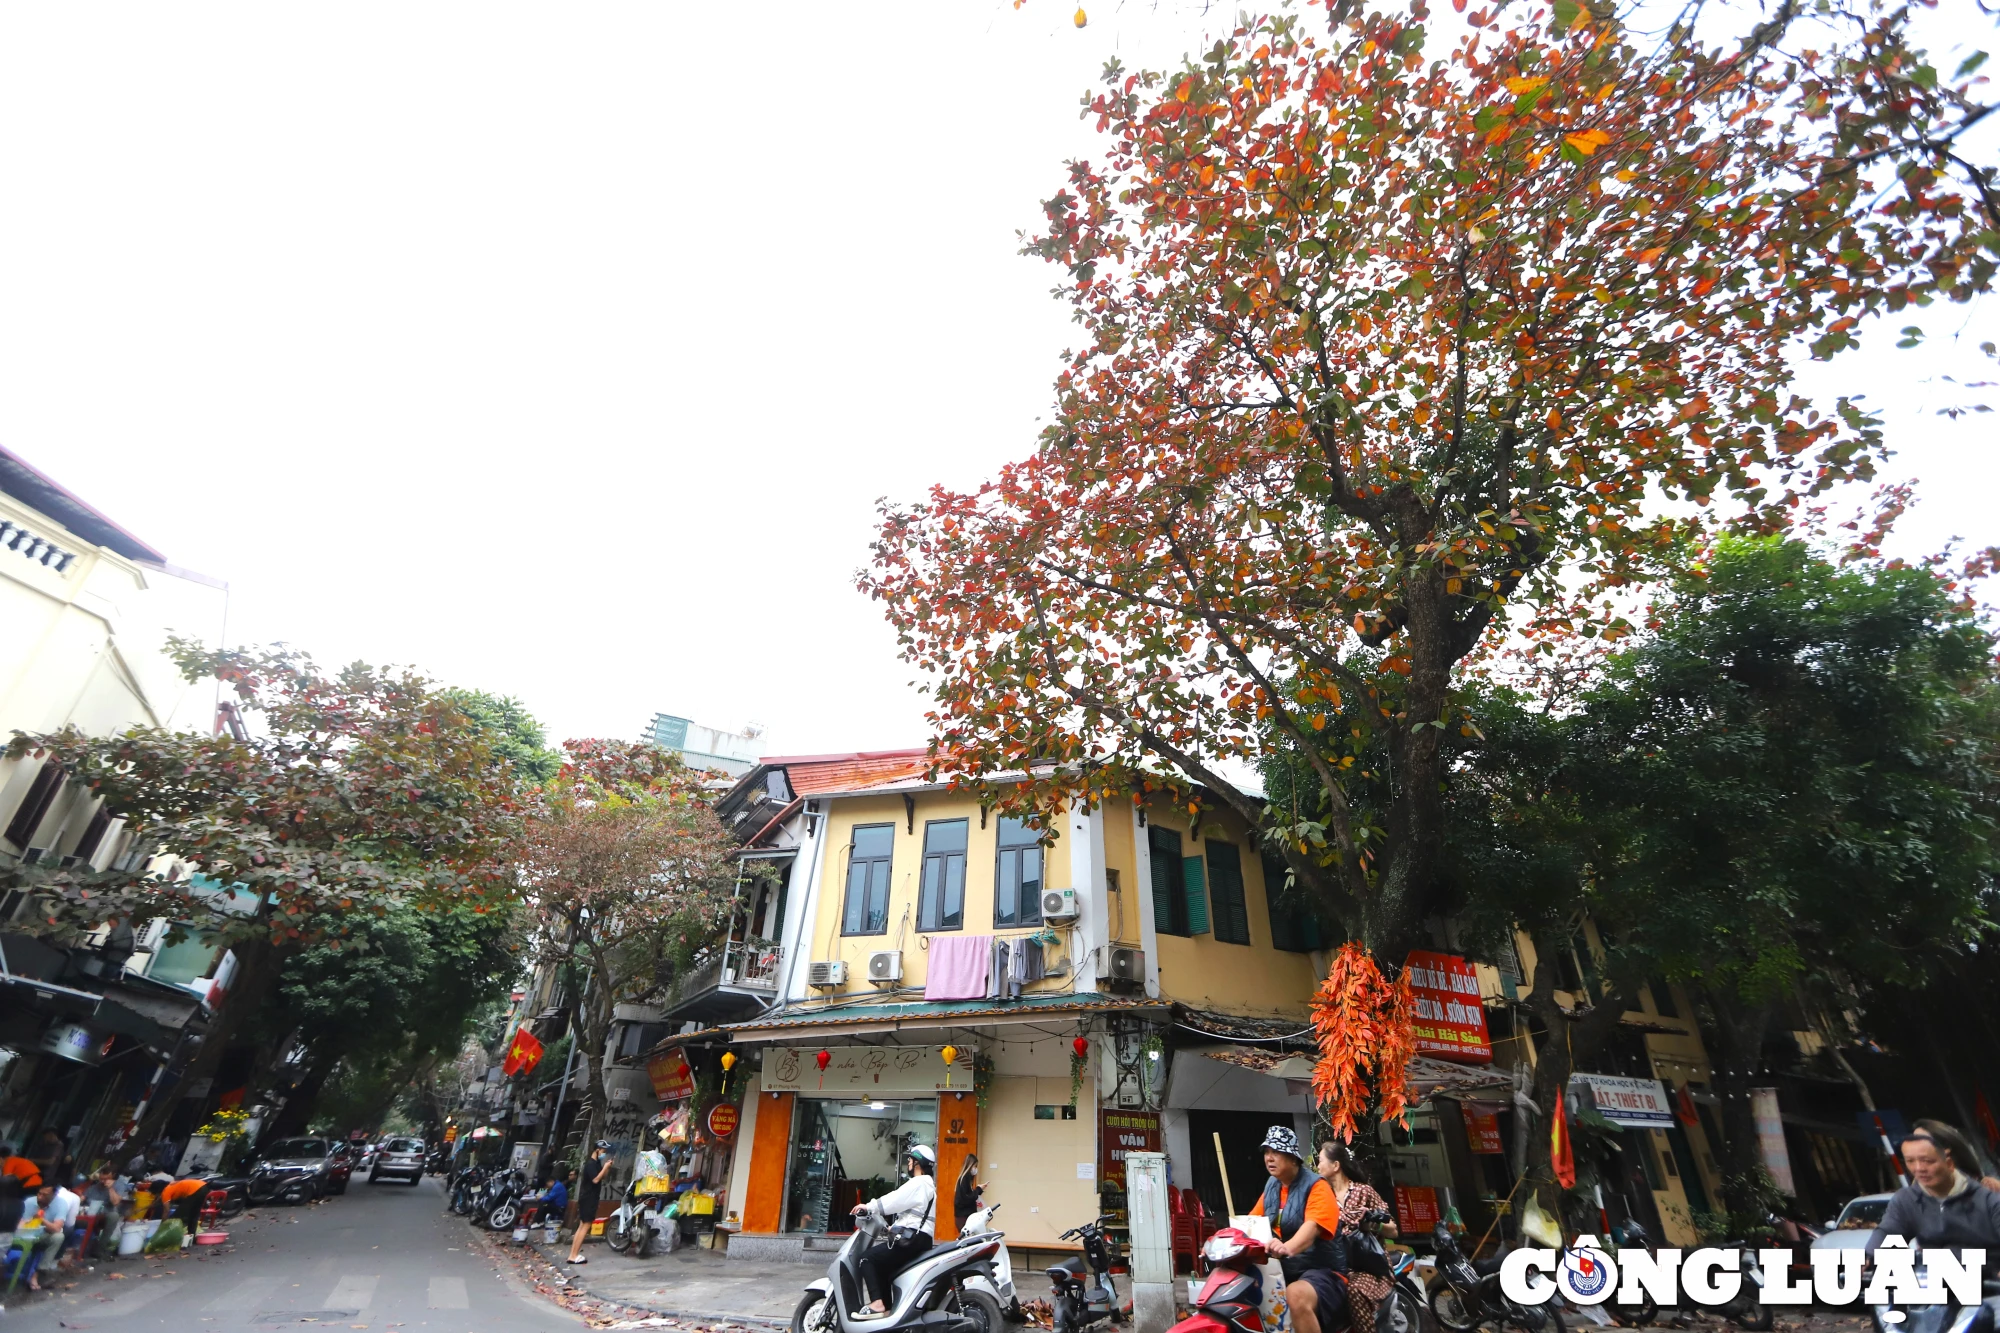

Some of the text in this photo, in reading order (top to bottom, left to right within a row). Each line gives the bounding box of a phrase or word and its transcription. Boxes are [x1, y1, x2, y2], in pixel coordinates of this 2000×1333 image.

[1437, 1028, 1458, 1041] Hải
[1460, 1031, 1482, 1044] Sản
[950, 1118, 965, 1134] 97
[1119, 1132, 1145, 1147] VÂN
